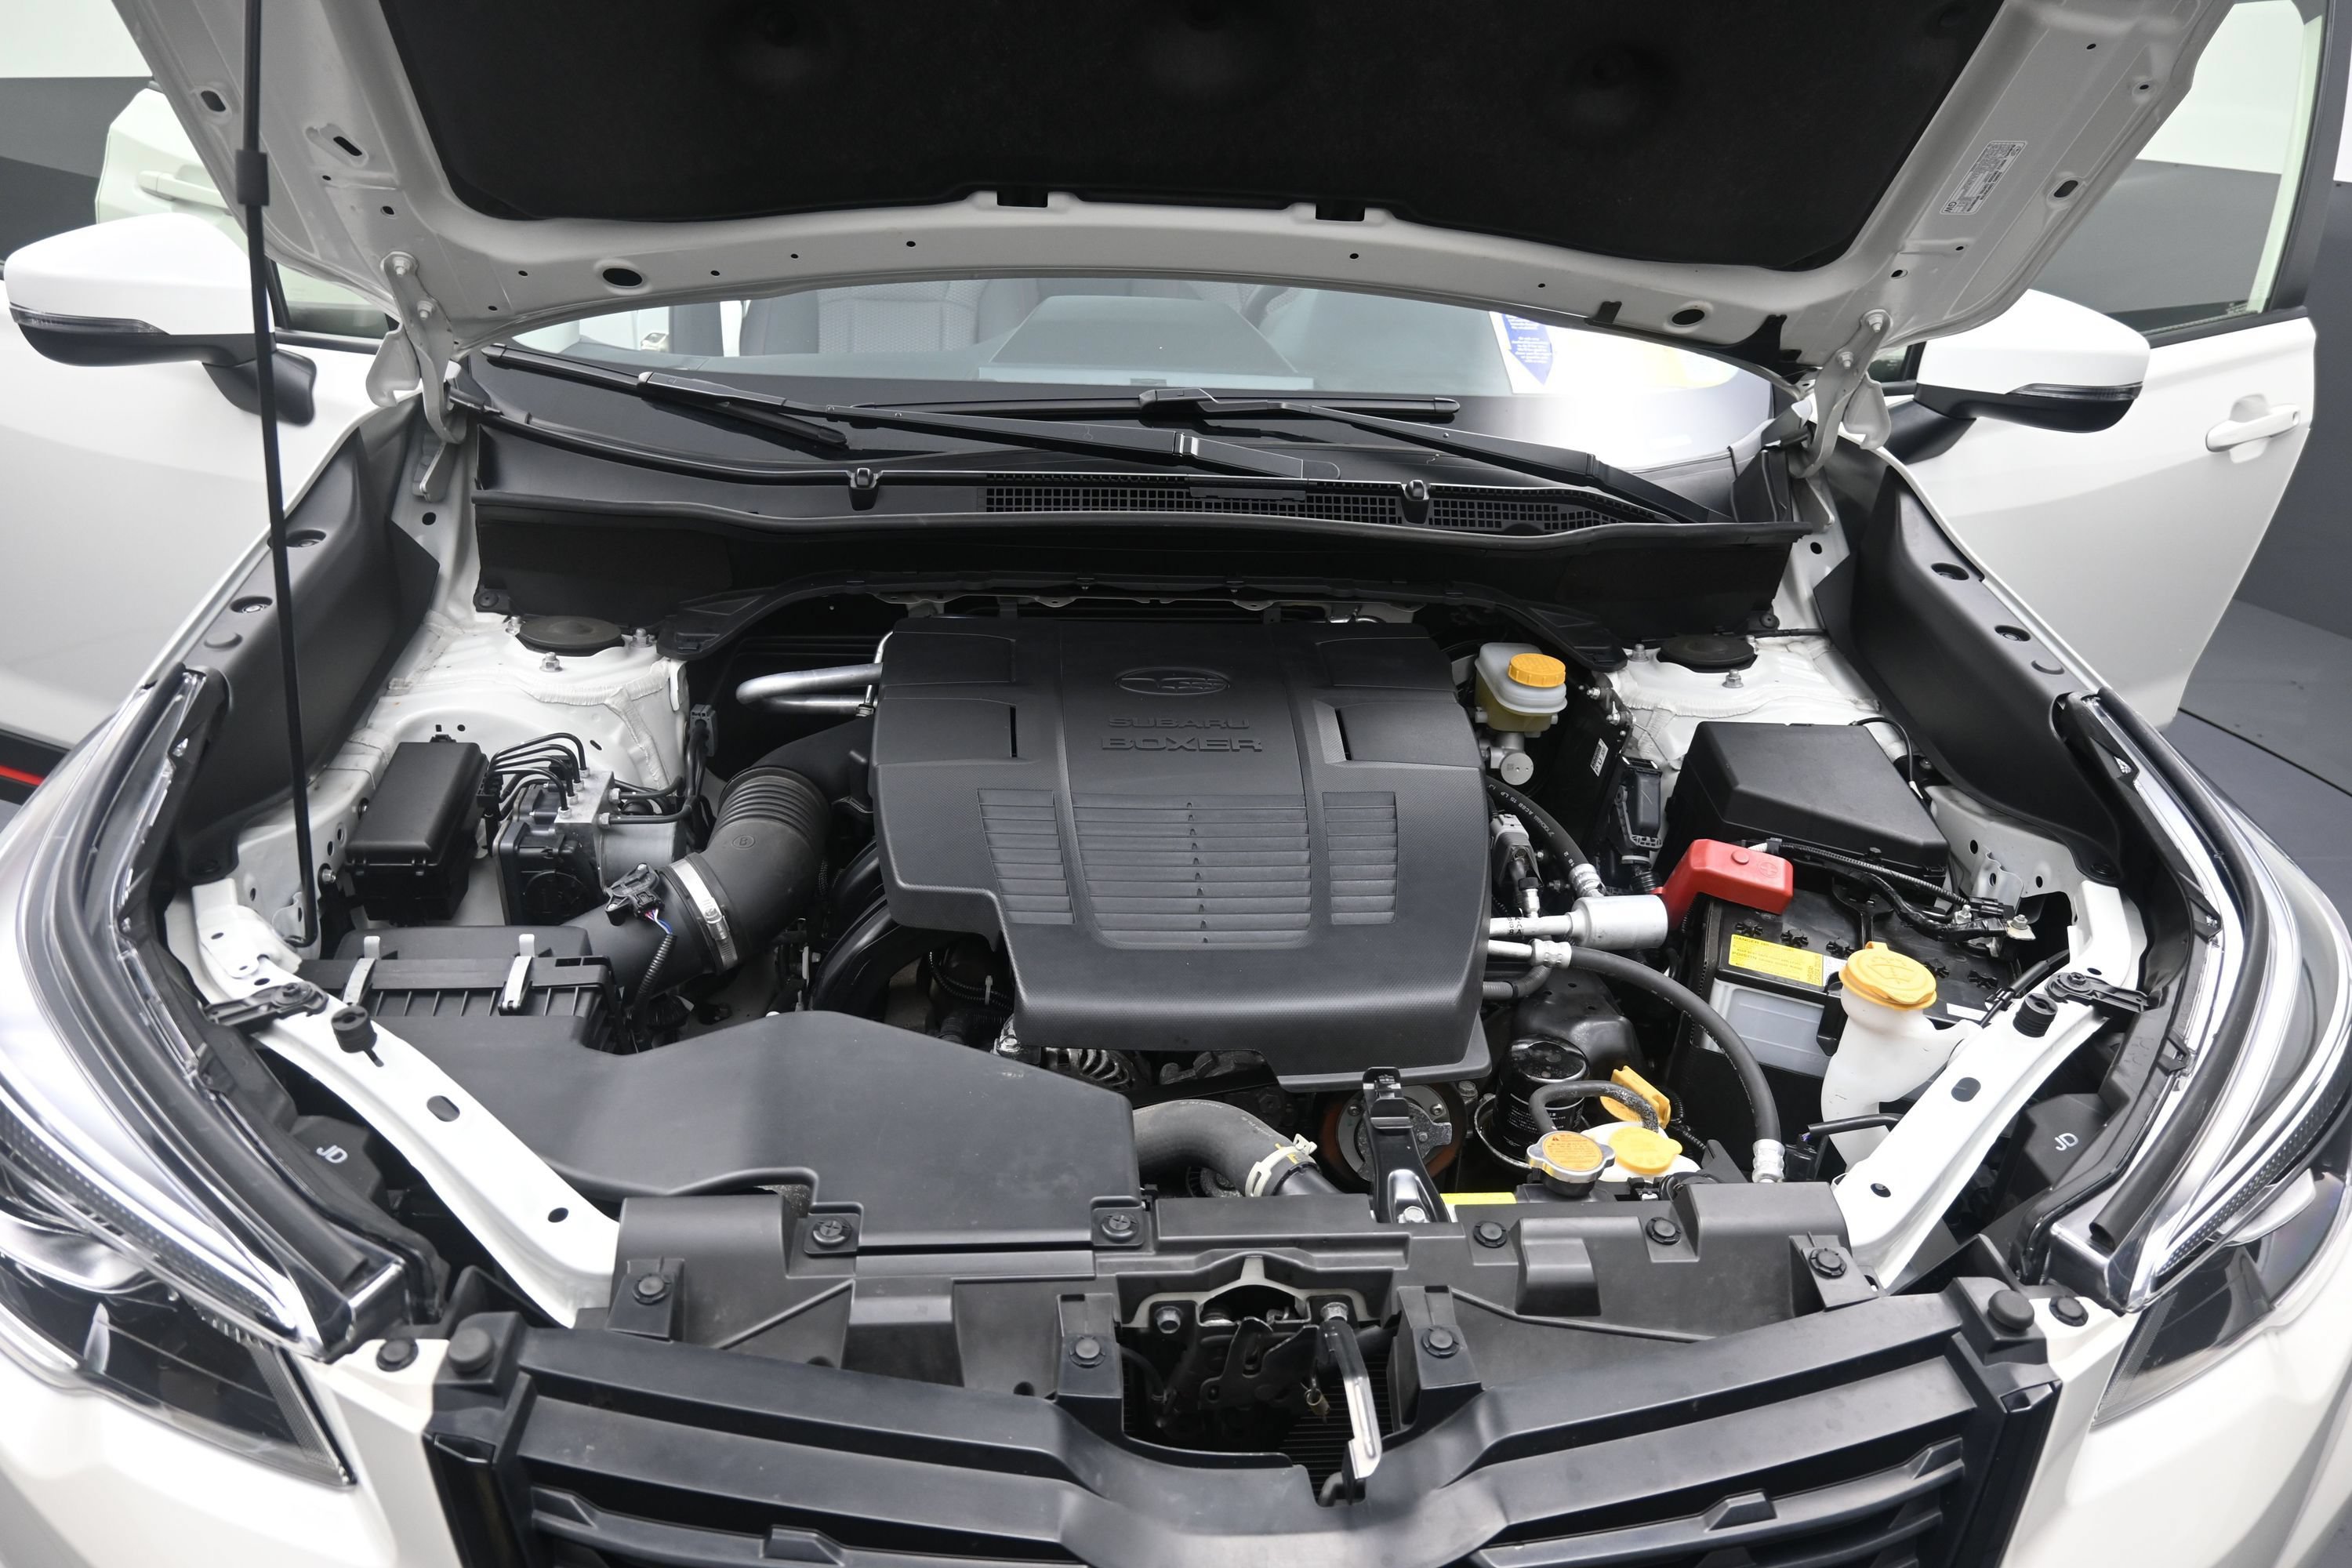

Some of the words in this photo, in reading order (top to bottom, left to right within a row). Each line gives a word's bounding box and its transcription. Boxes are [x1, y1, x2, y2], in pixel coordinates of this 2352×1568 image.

[1944, 201, 1957, 212] GW
[1109, 717, 1250, 729] SUBARU
[1102, 736, 1263, 752] BOXER
[1733, 936, 1759, 945] DANGER
[1732, 951, 1757, 960] POISON
[2054, 1132, 2078, 1151] JD
[316, 1145, 348, 1163] JD
